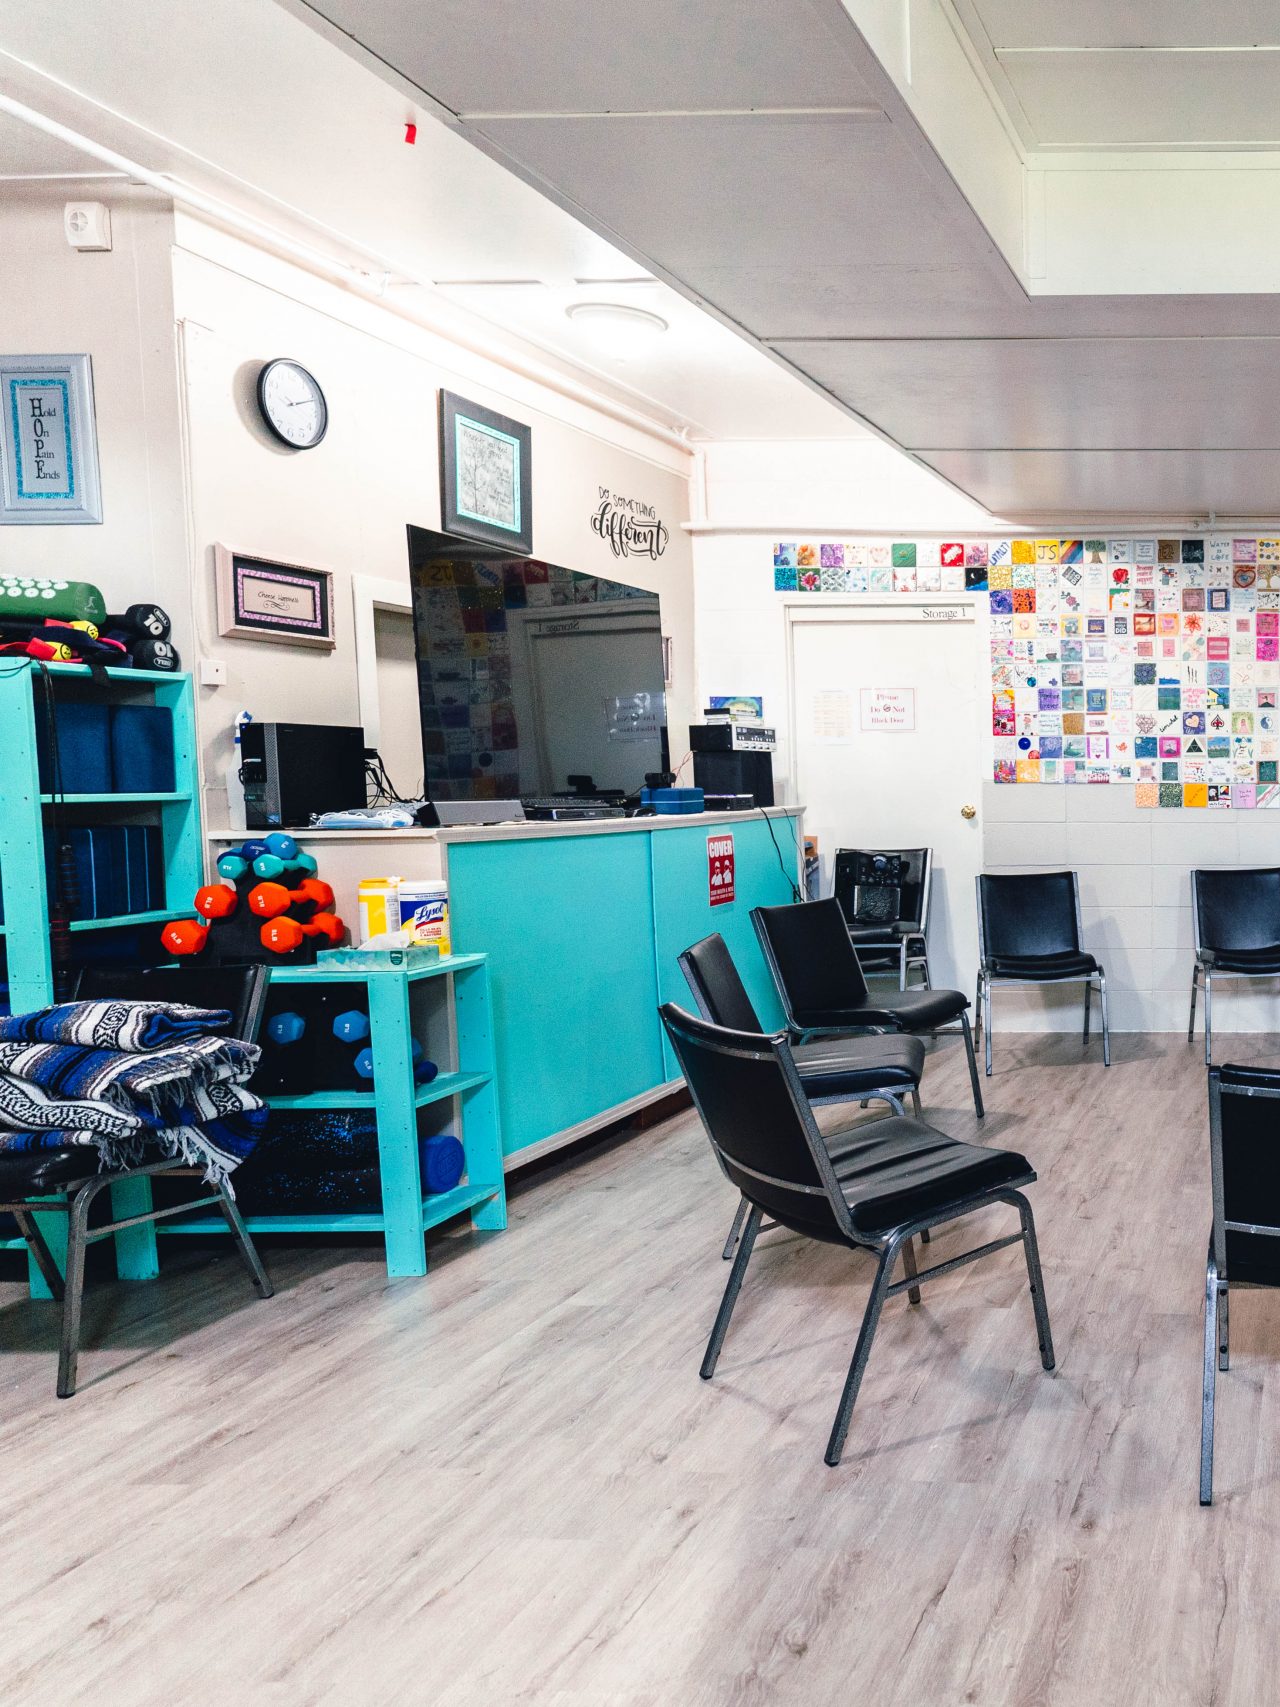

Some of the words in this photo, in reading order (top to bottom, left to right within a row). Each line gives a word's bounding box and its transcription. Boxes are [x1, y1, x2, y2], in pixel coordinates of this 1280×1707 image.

[29, 398, 56, 418] Hold
[34, 418, 49, 438] On
[34, 439, 54, 458] Pain
[35, 460, 60, 479] Ends
[599, 486, 609, 499] DO
[613, 494, 655, 520] SOMETHING
[593, 502, 667, 560] different
[1038, 545, 1056, 560] JS
[922, 608, 958, 619] Storage
[962, 608, 966, 616] 1
[144, 613, 163, 635] 10
[154, 641, 173, 658] 10
[709, 840, 733, 858] COVER
[416, 902, 443, 921] Lysol
